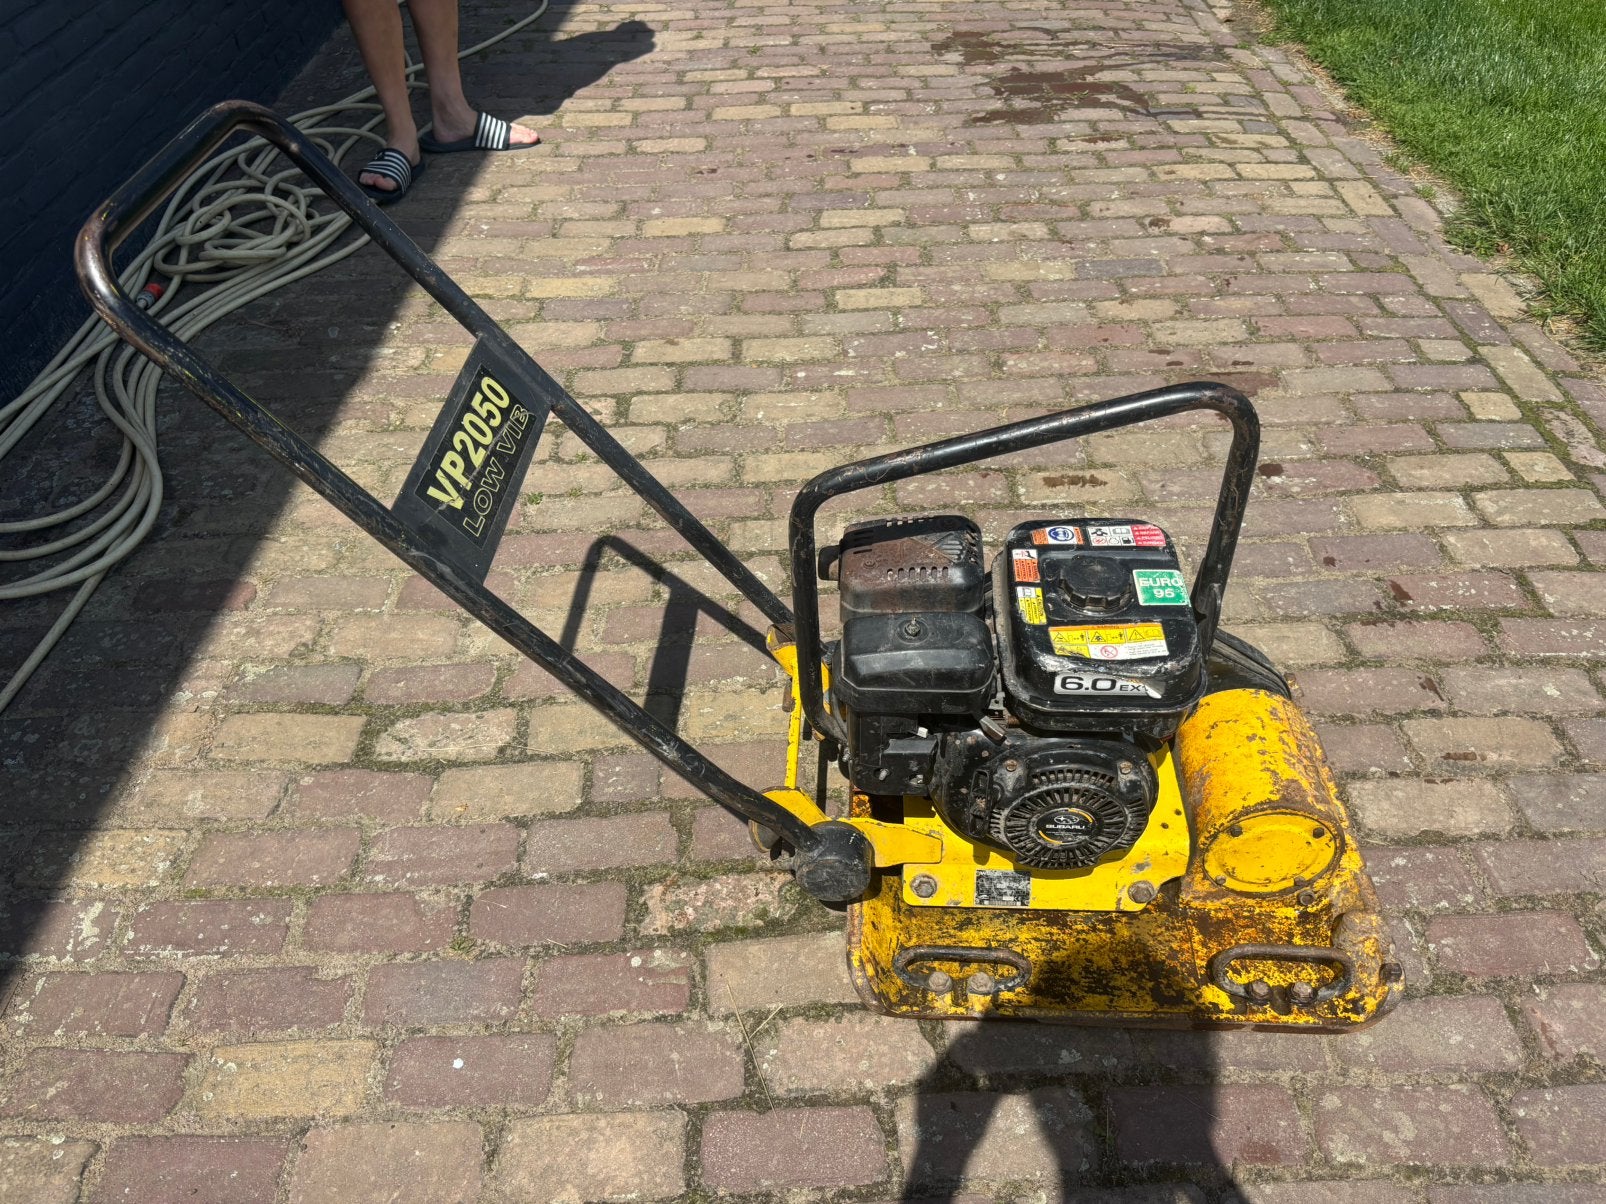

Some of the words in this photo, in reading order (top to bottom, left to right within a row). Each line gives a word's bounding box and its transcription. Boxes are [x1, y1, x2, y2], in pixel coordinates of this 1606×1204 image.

[427, 376, 510, 510] VP2050
[462, 457, 505, 537] LOW
[1139, 577, 1184, 587] EURO
[1060, 676, 1117, 691] 6.0
